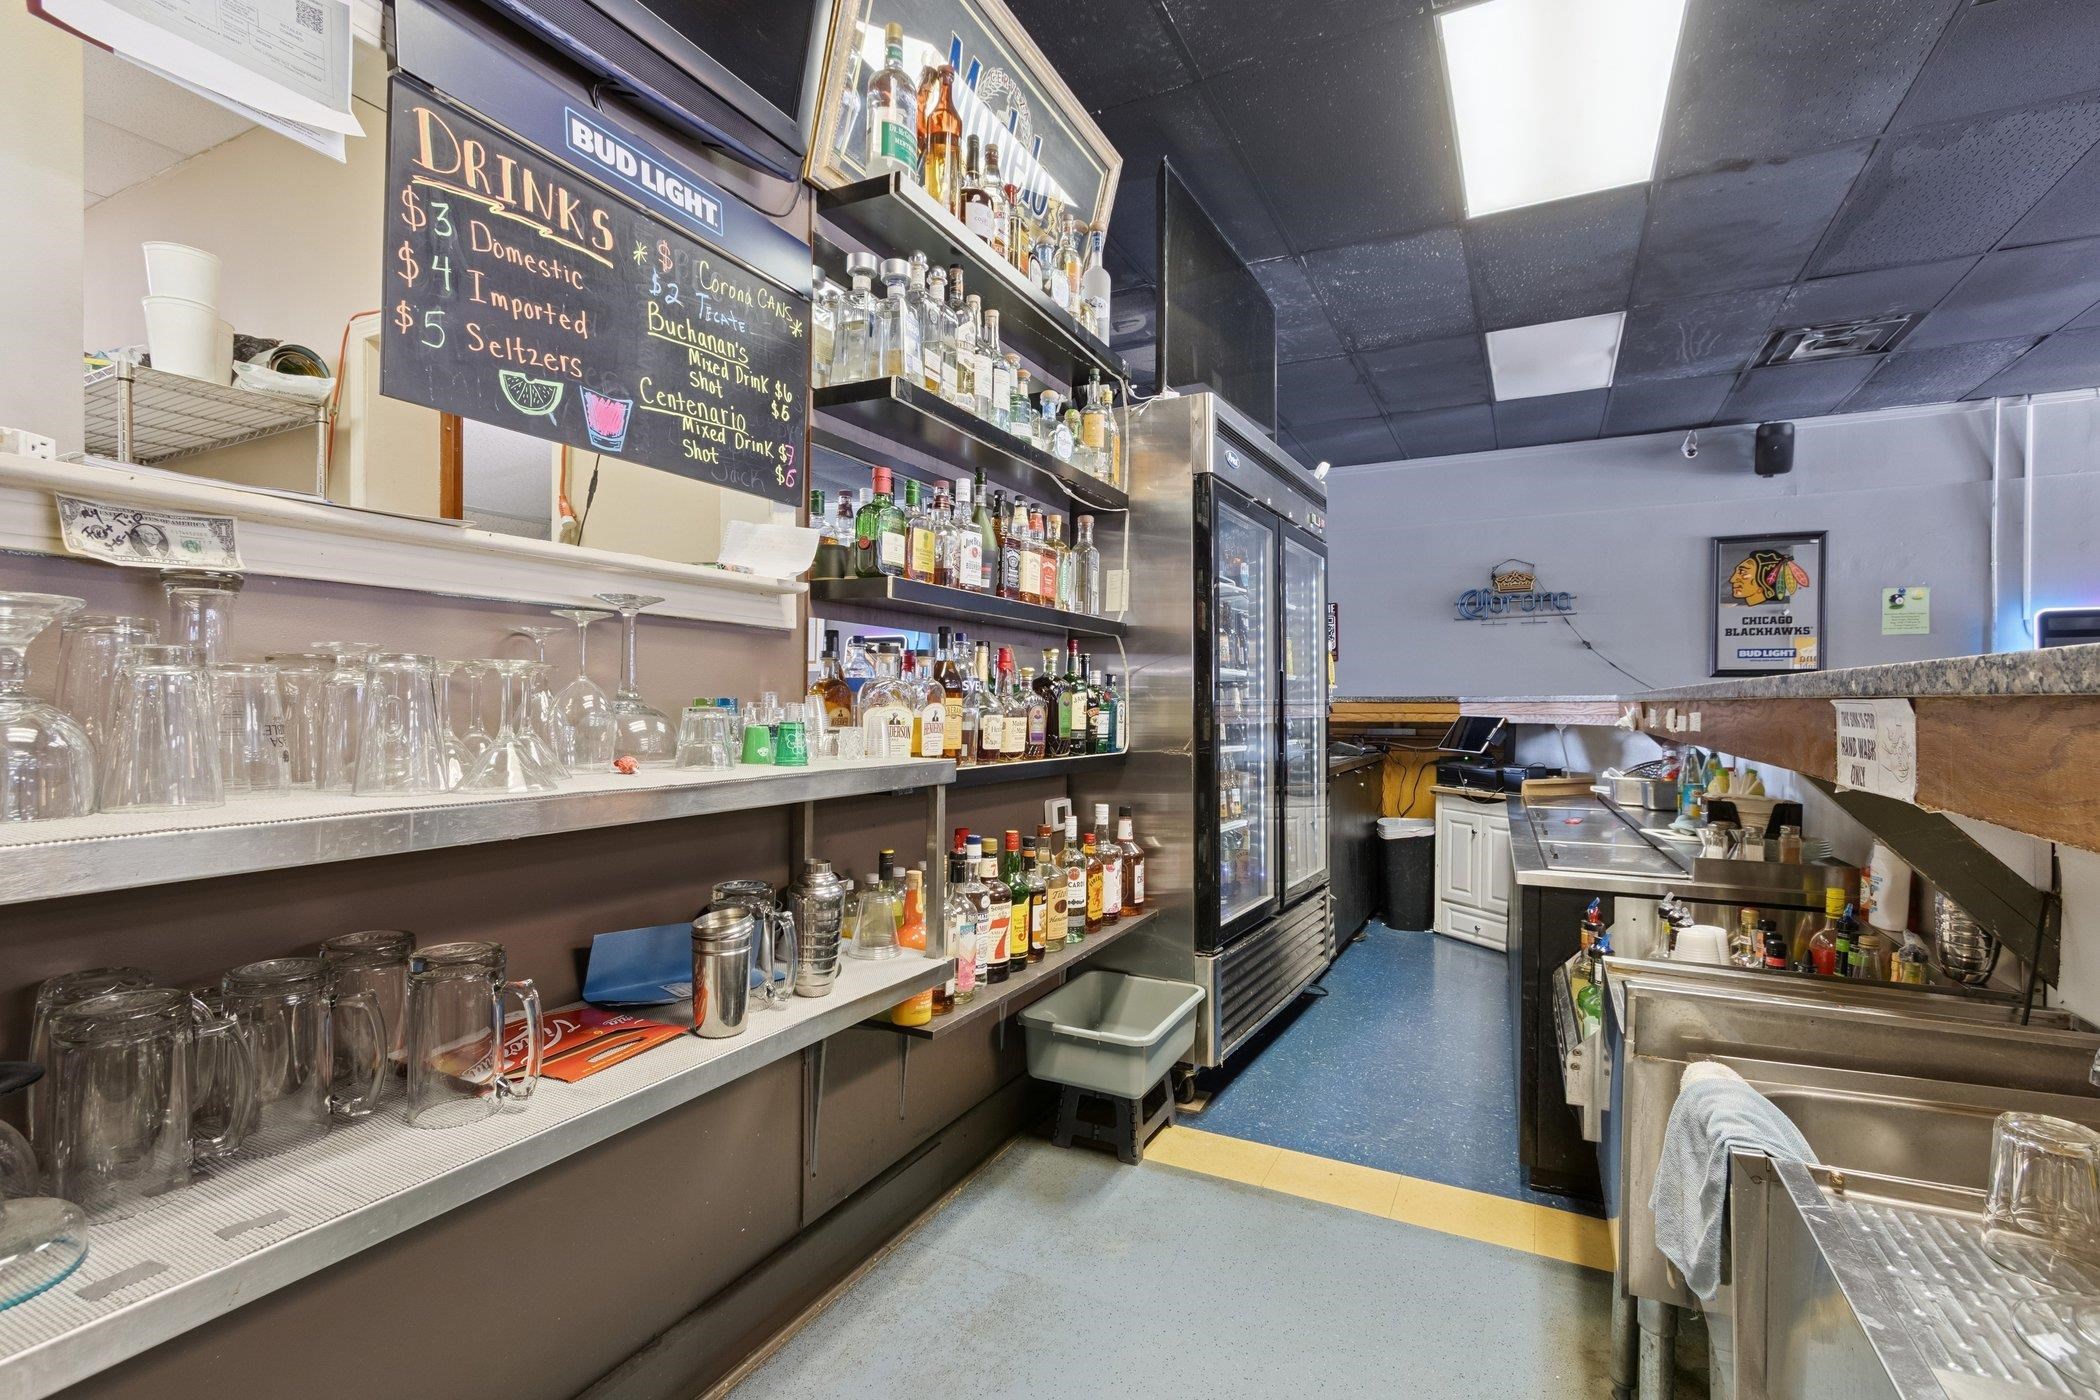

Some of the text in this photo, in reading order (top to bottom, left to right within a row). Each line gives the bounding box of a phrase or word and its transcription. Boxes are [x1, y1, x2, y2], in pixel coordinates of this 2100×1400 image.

[572, 118, 638, 177] BUD
[412, 107, 614, 251] DRINKS
[470, 220, 584, 290] Domestic
[466, 269, 588, 339] Imported
[699, 261, 753, 309] Corona
[465, 323, 584, 378] Seltzers
[648, 301, 749, 364] Buchanan's
[688, 347, 730, 380] Mixed
[735, 365, 769, 395] Drink
[689, 371, 724, 399] Shot
[639, 376, 747, 431] Centenario
[682, 415, 726, 445] Mixed
[735, 432, 775, 459] Drink
[682, 439, 719, 465] Shot
[1456, 587, 1574, 621] Corona
[1742, 615, 1793, 626] CHICAGO
[1725, 627, 1811, 637] BLACKHAWKS
[1738, 649, 1795, 658] BUD LIGHT
[1841, 736, 1877, 761] HAND WASH
[1850, 764, 1866, 788] ONLY
[989, 915, 1011, 960] 7
